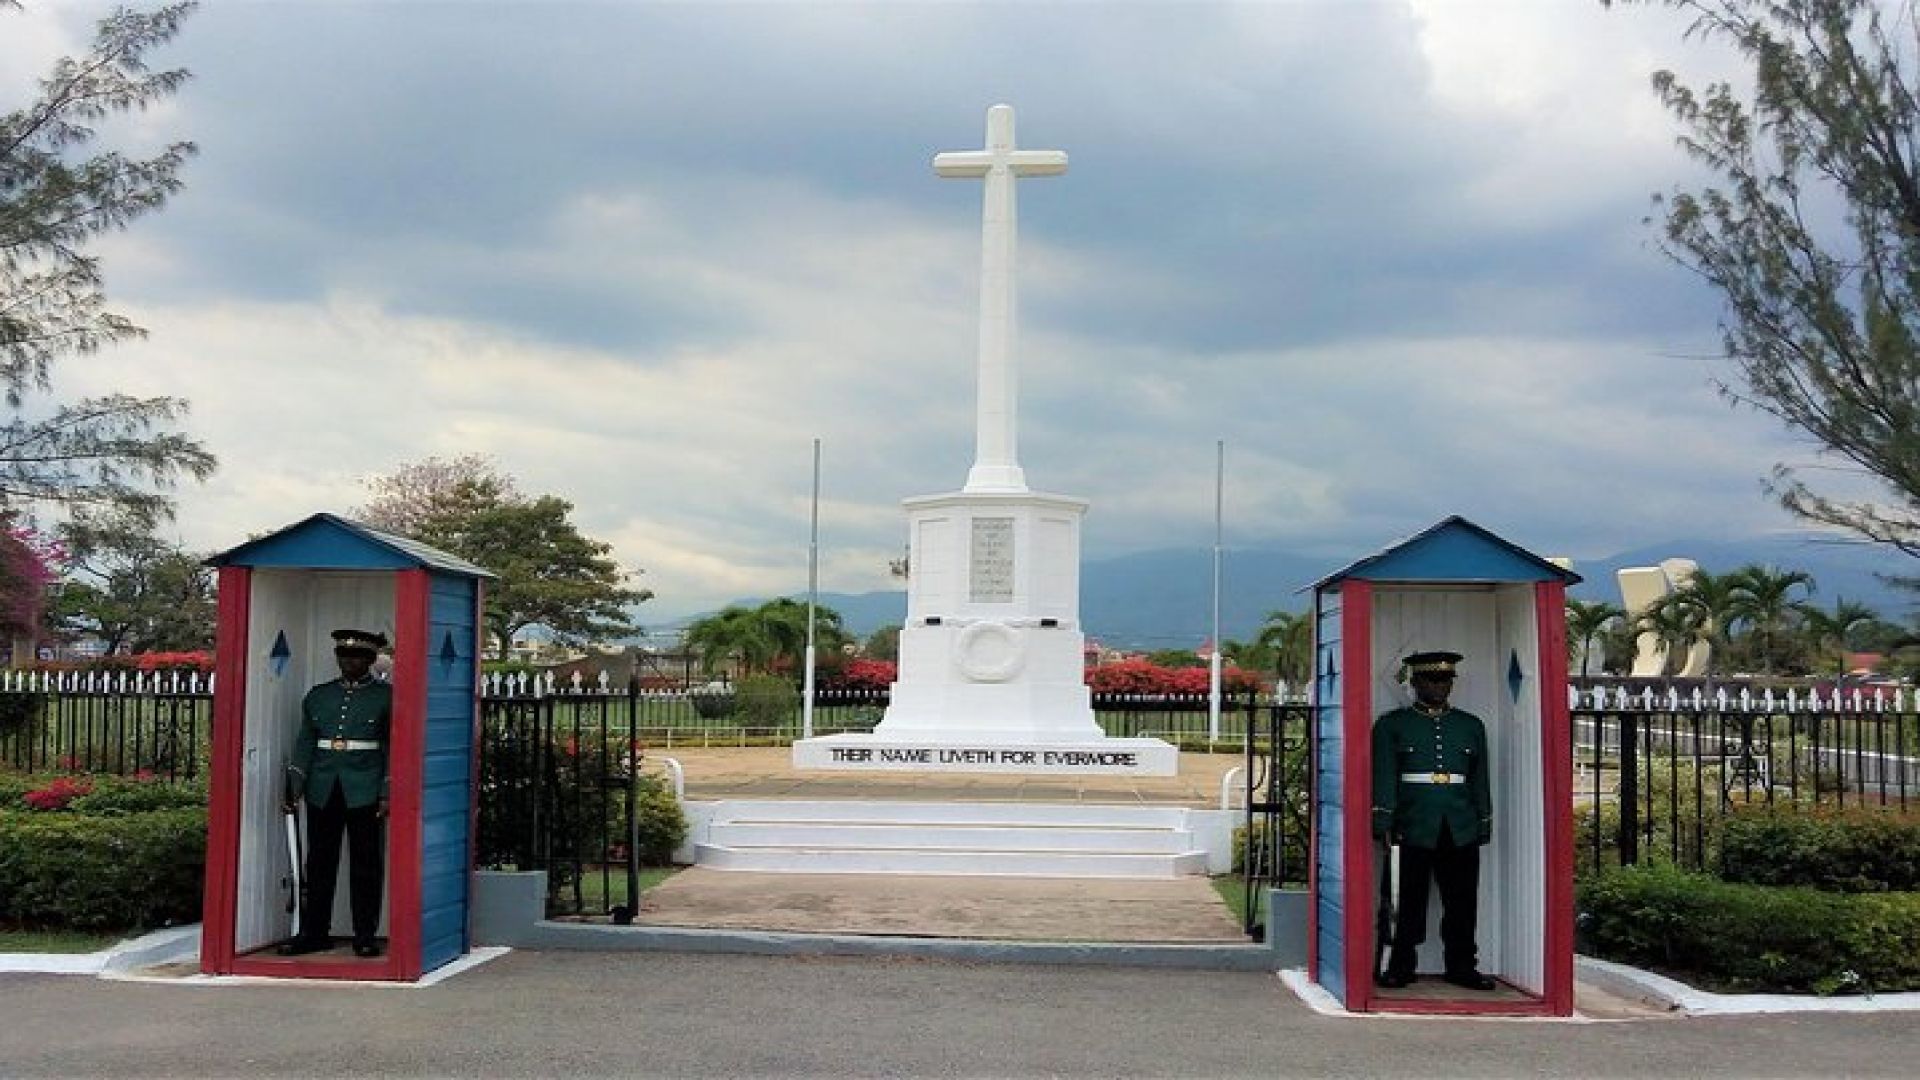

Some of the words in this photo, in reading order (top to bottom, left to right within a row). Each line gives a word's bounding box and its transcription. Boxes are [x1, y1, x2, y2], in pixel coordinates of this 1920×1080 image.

[832, 748, 872, 762] THEIR
[880, 748, 932, 763] NAME
[939, 749, 995, 764] LIVETH
[1001, 750, 1037, 764] FOR
